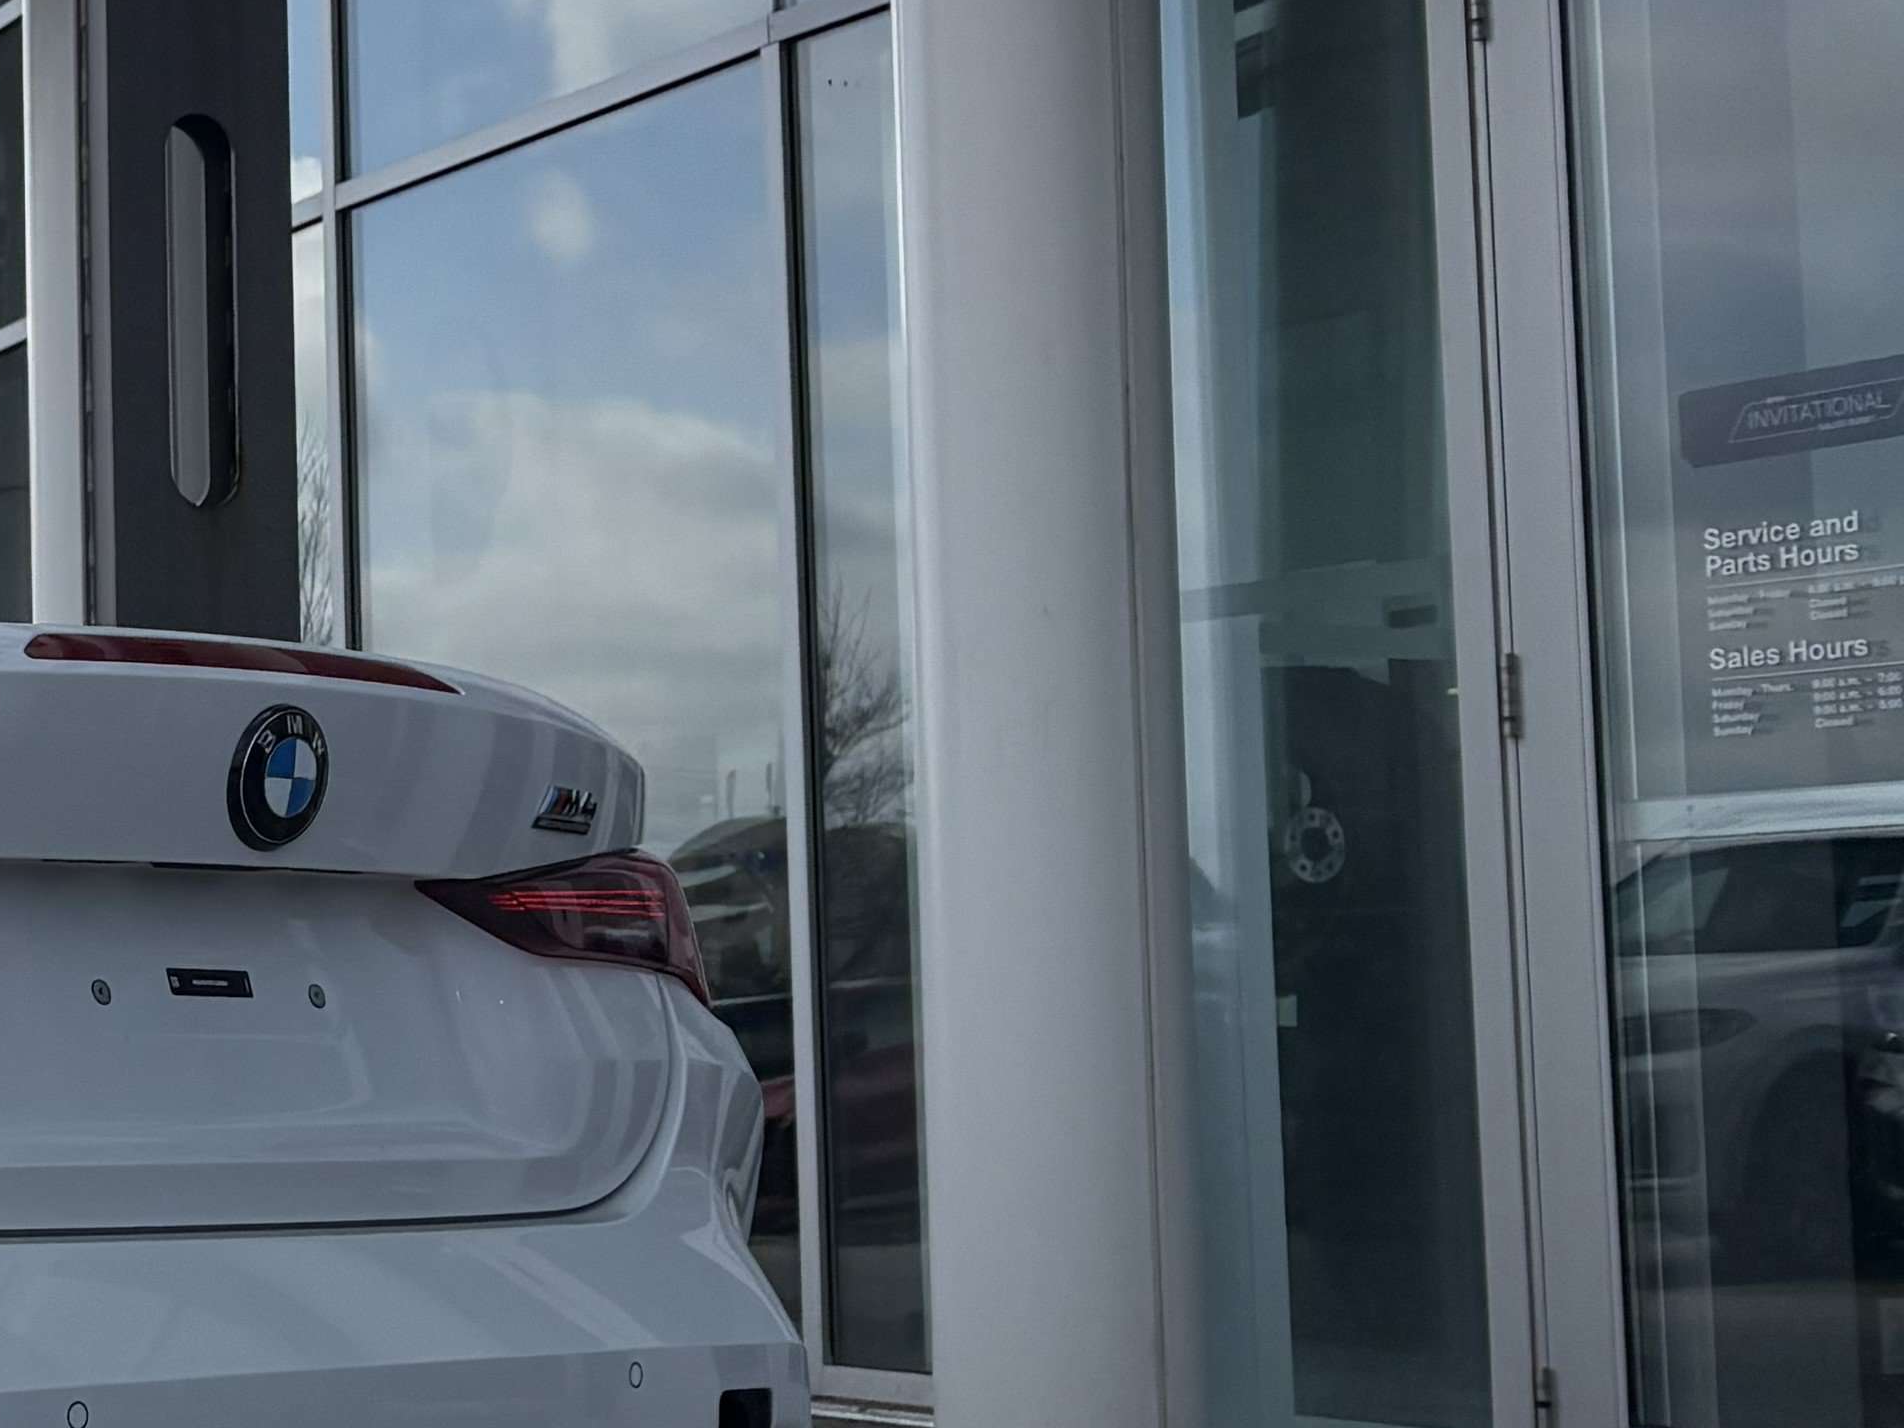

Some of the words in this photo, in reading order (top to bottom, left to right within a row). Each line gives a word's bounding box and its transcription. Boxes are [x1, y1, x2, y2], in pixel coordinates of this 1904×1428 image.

[1703, 521, 1801, 551] Service
[1810, 510, 1859, 538] and
[1706, 552, 1771, 577] Parts
[1780, 543, 1859, 569] Hours
[1709, 646, 1780, 670] Sales
[1789, 638, 1869, 663] Hours
[257, 714, 326, 757] BMW
